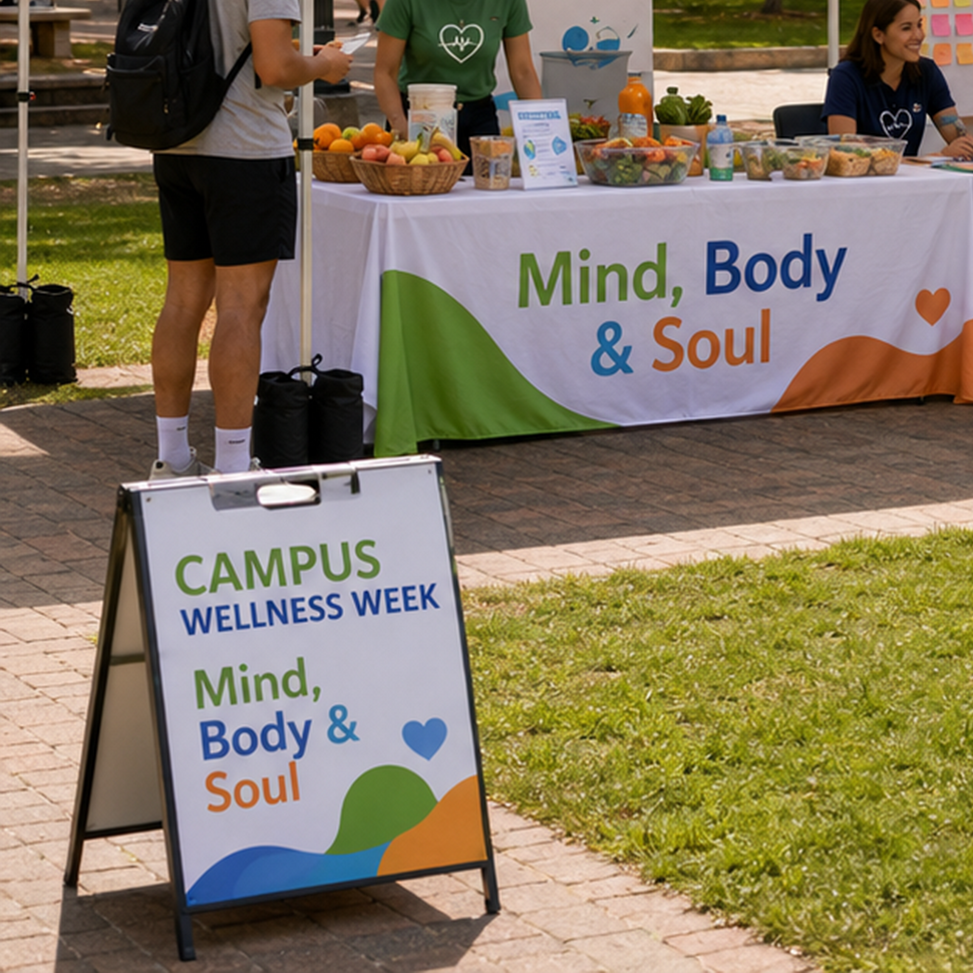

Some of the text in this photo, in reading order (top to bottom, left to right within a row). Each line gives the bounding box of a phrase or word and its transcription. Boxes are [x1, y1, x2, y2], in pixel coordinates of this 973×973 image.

[518, 233, 847, 308] Mind, Body
[590, 307, 771, 377] & Soul
[175, 539, 381, 596] CAMPUS
[180, 583, 440, 636] WELLNESS WEEK
[194, 656, 321, 709] Mind,
[199, 704, 360, 761] Body &
[204, 760, 301, 813] Soul
